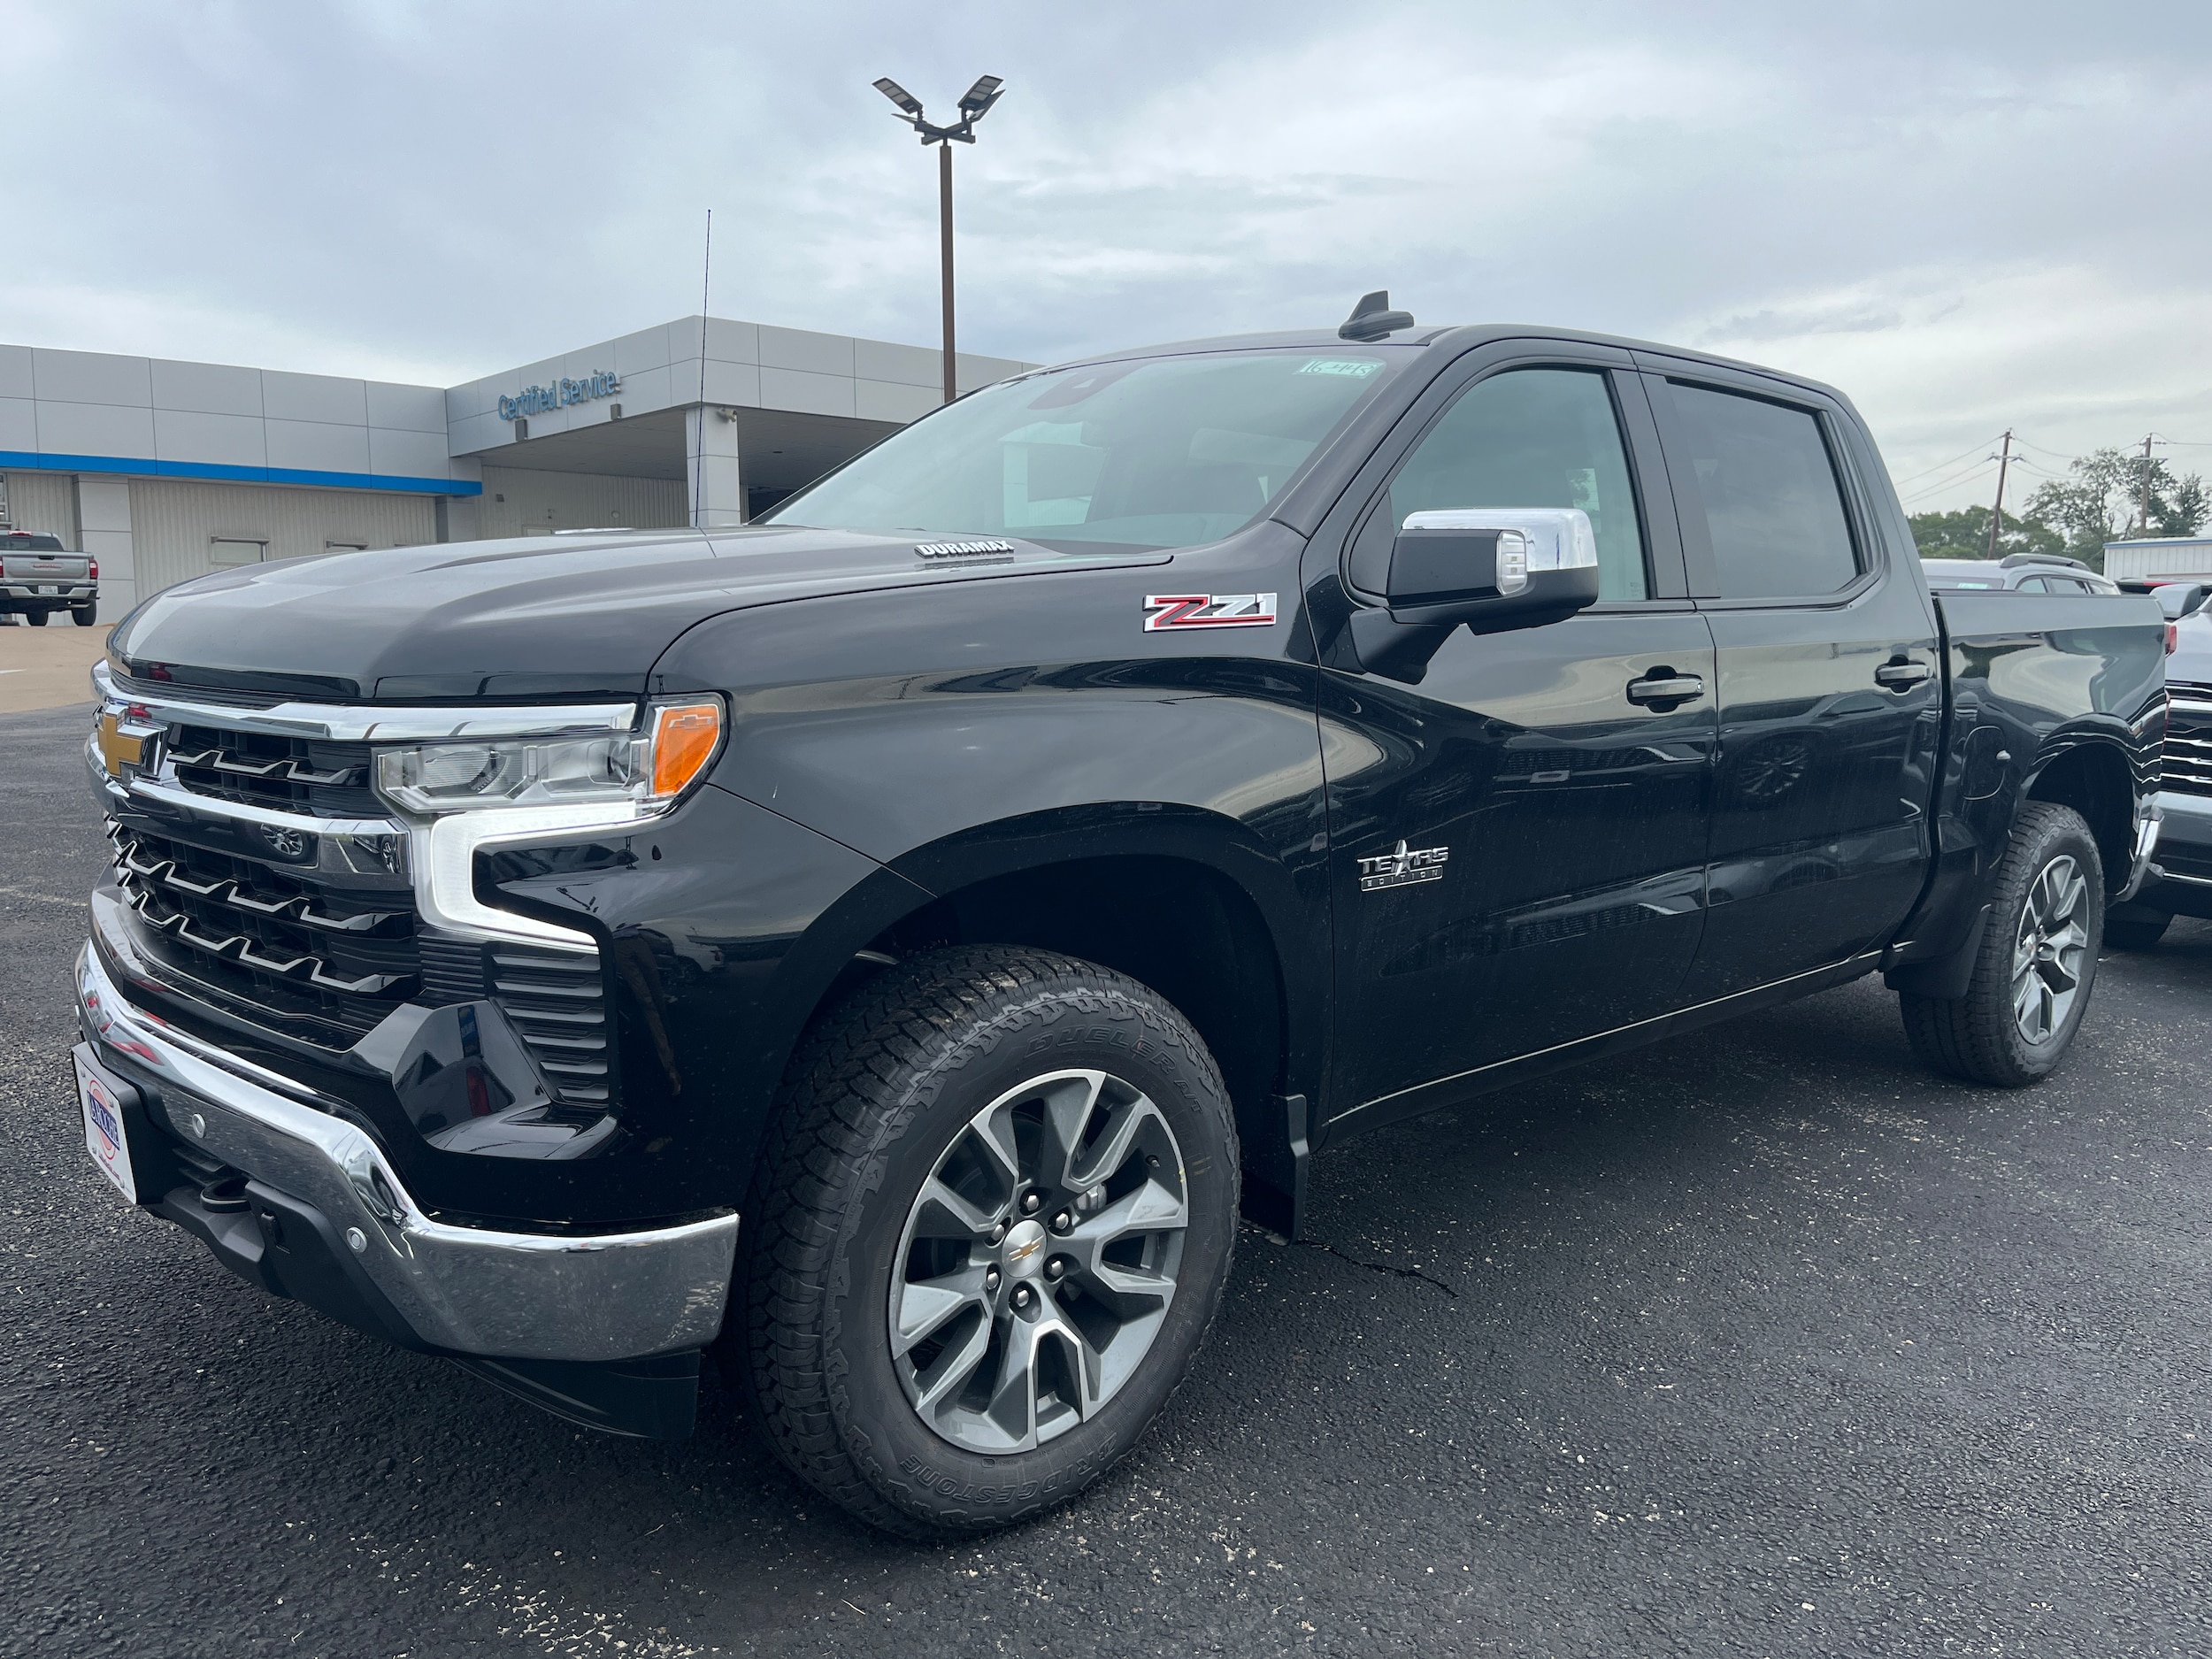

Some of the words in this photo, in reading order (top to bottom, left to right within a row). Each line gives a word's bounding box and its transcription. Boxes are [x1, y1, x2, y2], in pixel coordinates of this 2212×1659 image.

[498, 380, 557, 420] Certified
[560, 369, 617, 405] Service
[915, 540, 1015, 558] DURAMAX
[1143, 592, 1278, 632] Z71
[1357, 840, 1449, 877] TEXAS
[1367, 869, 1439, 887] EDITION
[1024, 1024, 1176, 1075] DUELER
[900, 1432, 1118, 1503] BRIDGESTONE
